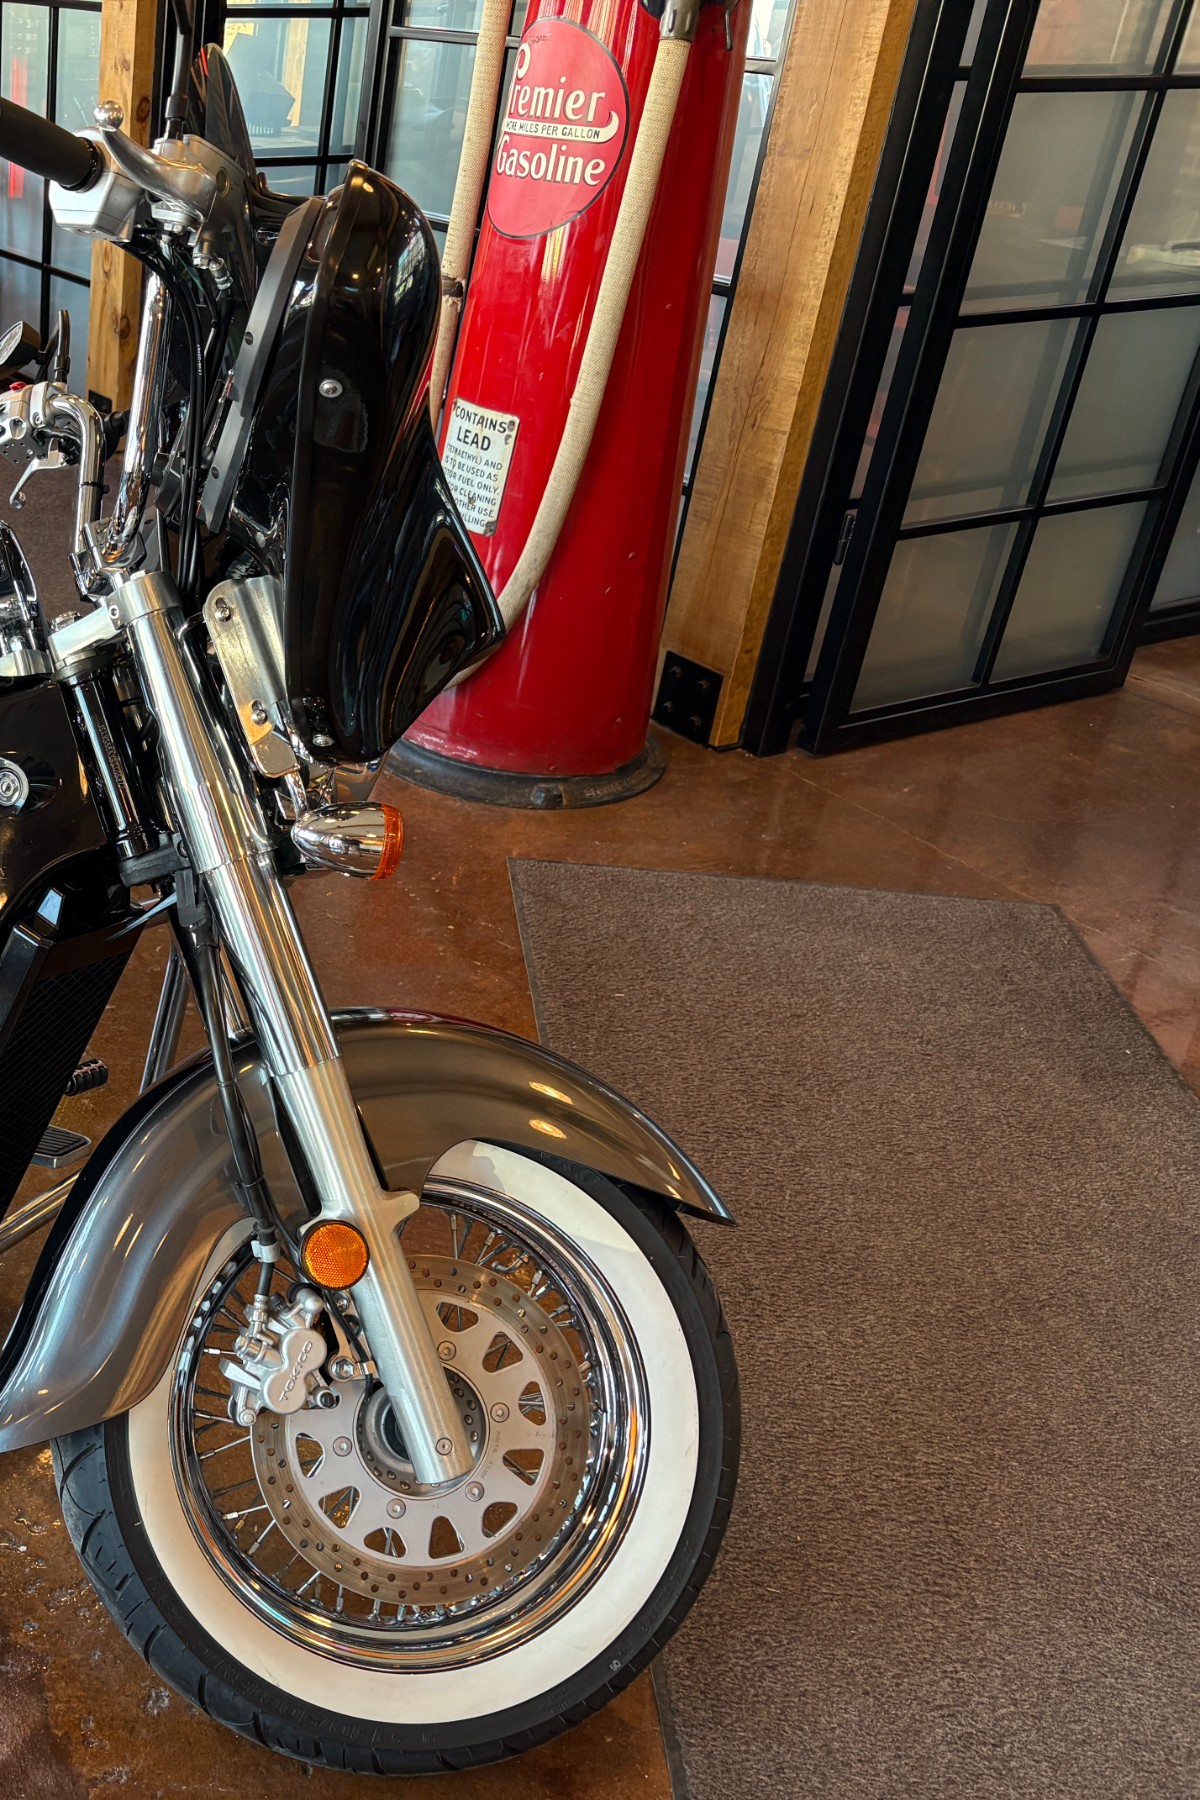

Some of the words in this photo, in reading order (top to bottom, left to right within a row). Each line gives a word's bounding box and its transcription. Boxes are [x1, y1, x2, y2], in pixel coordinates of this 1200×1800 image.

[505, 42, 606, 123] Premier
[518, 123, 539, 133] MILES
[541, 125, 559, 136] PER
[561, 126, 601, 139] GALLON
[496, 134, 606, 187] Gasoline
[455, 404, 508, 434] CONTAINS
[456, 425, 492, 452] LEAD
[457, 461, 466, 472] BE
[466, 465, 486, 478] USED
[486, 472, 499, 482] AS
[483, 459, 503, 471] AND
[458, 474, 475, 488] FUEL
[459, 487, 497, 507] CLEANING
[279, 1339, 313, 1403] TOKICO
